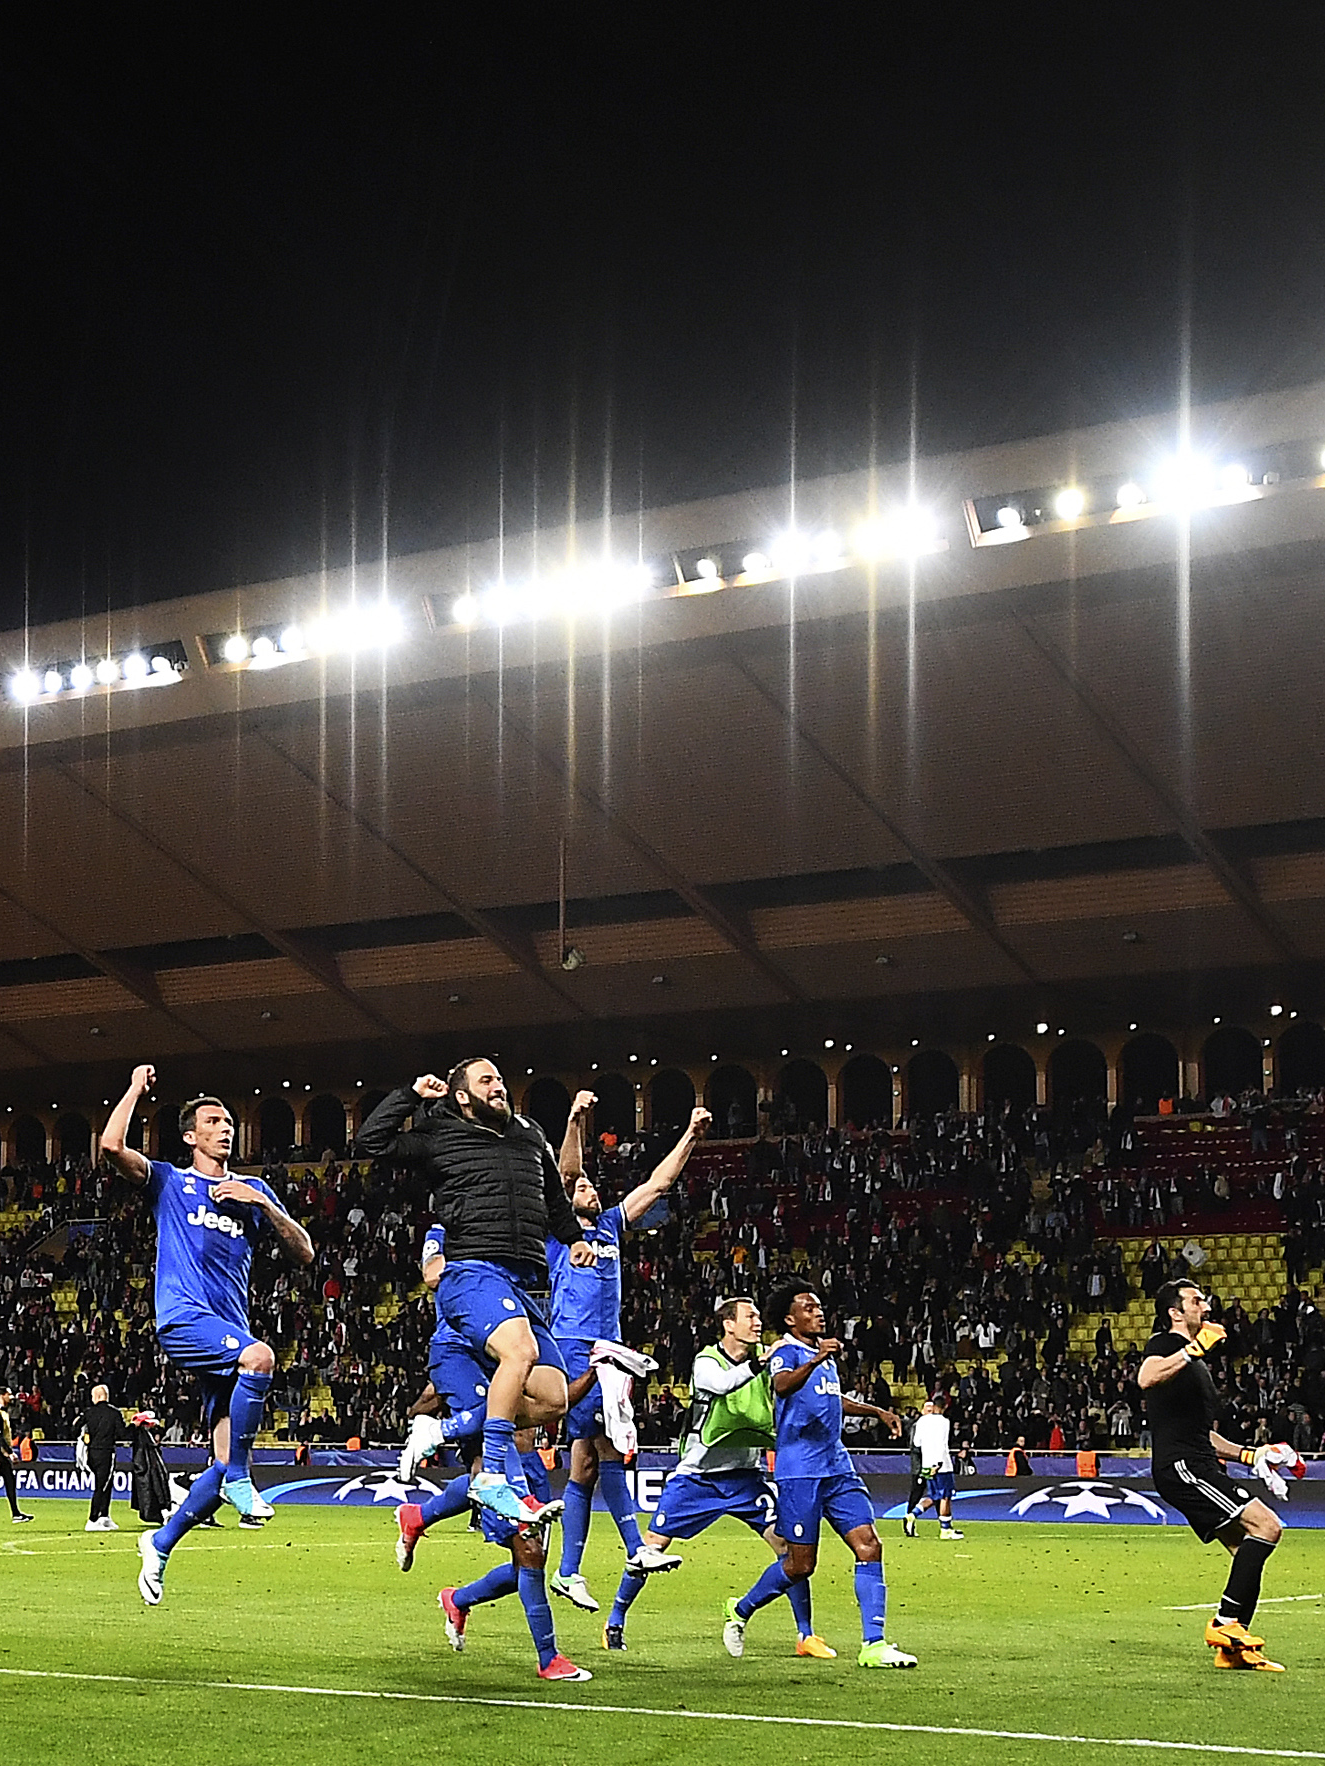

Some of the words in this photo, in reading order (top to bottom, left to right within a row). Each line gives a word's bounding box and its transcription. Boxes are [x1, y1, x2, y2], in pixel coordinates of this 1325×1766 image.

[187, 1204, 245, 1239] Jeep
[814, 1376, 841, 1395] Jee
[755, 1493, 778, 1523] 2
